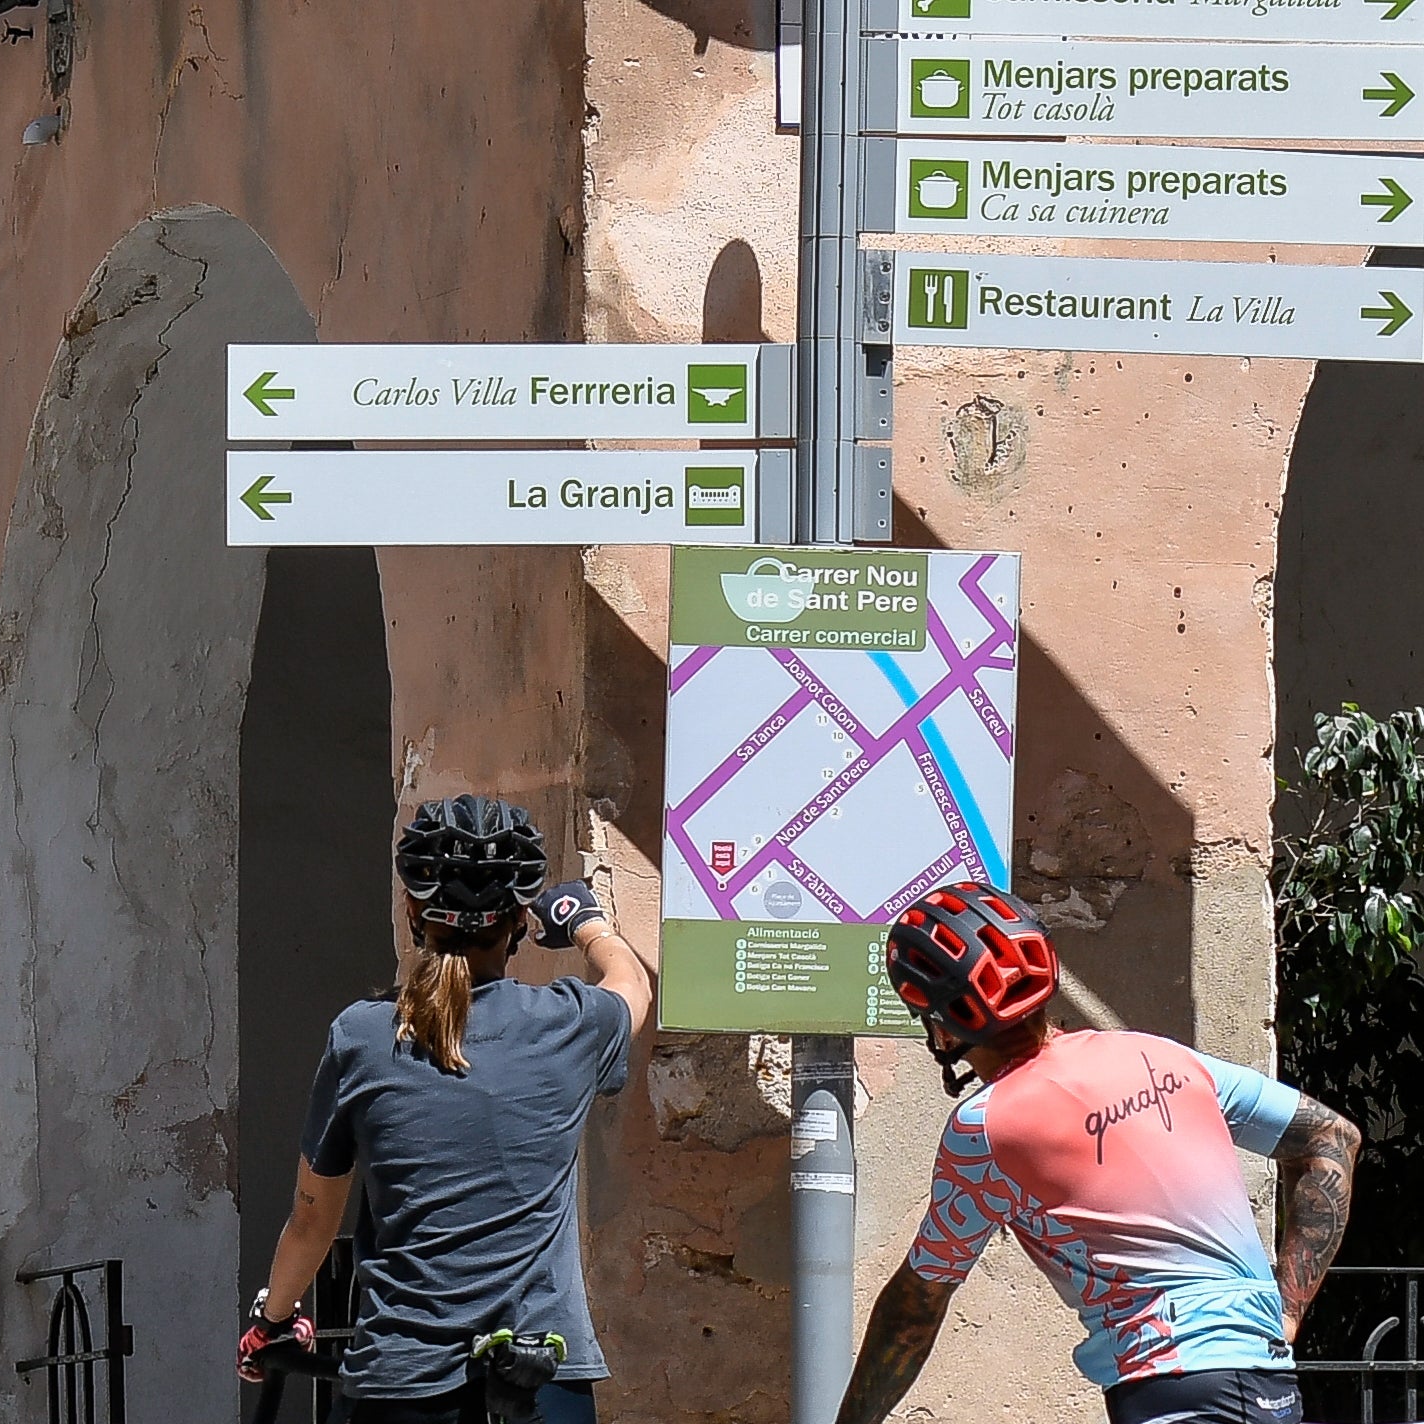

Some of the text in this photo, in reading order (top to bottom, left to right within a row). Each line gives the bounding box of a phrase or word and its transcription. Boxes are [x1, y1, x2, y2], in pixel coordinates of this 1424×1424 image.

[984, 59, 1289, 99] Menjars preparats
[981, 93, 1115, 121] Tot casolà
[981, 160, 1288, 200] Menjars preparats
[980, 195, 1170, 226] Ca sa cuinera
[978, 286, 1296, 326] Restaurant La Villa
[352, 376, 676, 407] Carlos Villa Ferrreria
[508, 479, 674, 514] La Granja
[779, 563, 918, 586] Carrer Nou
[746, 587, 918, 612] de Sant Pere
[746, 625, 917, 647] Carrer comercial
[783, 657, 858, 734] Joanot Colom
[968, 688, 1007, 738] Sa Creu
[818, 715, 828, 723] 11
[833, 732, 843, 740] 10
[736, 715, 787, 761] Sa Tanca
[823, 770, 834, 778] 12
[776, 757, 871, 846] Nou de Sant Pere
[918, 752, 952, 812] Francesc
[945, 811, 961, 830] de
[955, 829, 977, 865] Borja
[787, 858, 805, 878] Sa
[802, 872, 845, 915] Fàbrica
[884, 853, 955, 916] Ramon Llull
[747, 927, 820, 939] Alimentació
